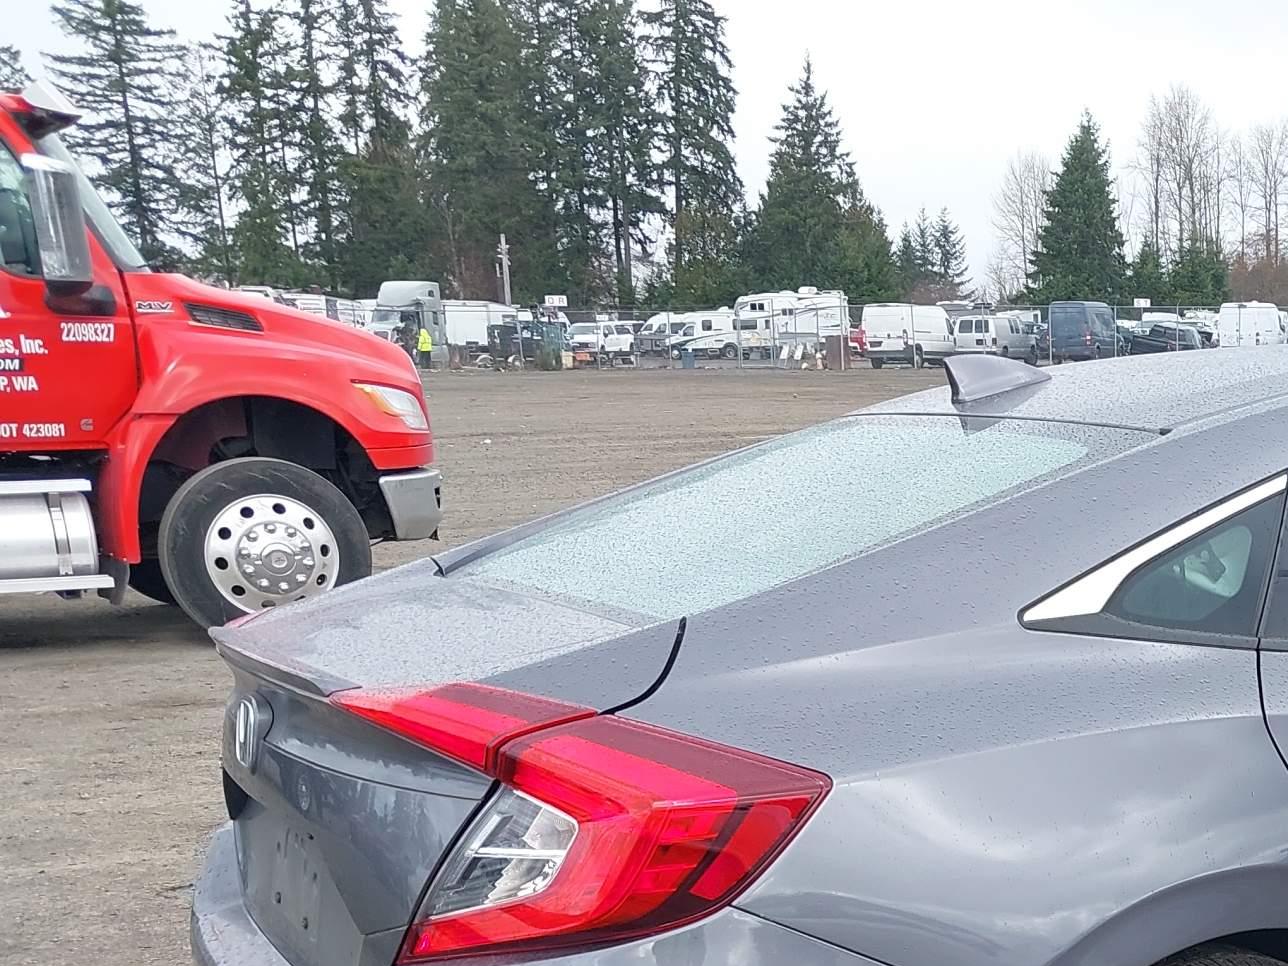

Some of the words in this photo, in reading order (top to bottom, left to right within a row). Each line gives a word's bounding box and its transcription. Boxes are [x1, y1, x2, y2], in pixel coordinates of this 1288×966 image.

[60, 322, 114, 342] 22098327
[20, 334, 49, 354] Inc.
[12, 376, 38, 391] WA
[0, 423, 18, 438] OT
[22, 423, 65, 437] 423081
